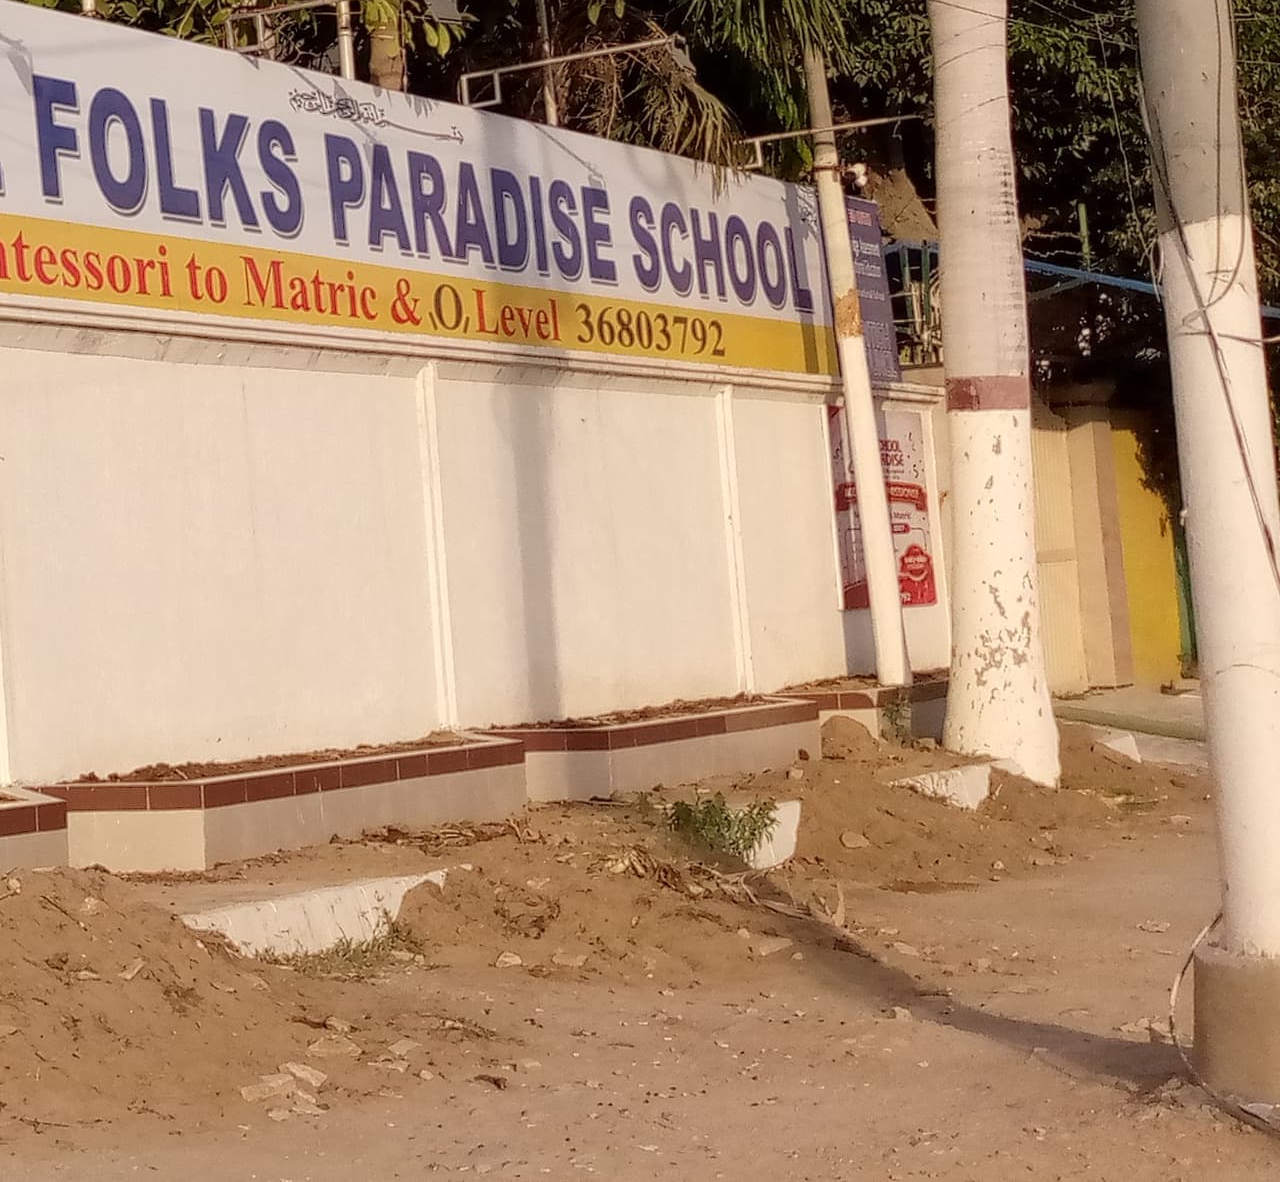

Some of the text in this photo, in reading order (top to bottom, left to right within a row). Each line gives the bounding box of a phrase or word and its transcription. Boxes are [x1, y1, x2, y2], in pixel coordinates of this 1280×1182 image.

[33, 73, 304, 239] FOLKS
[325, 132, 618, 286] PARADISE
[630, 195, 812, 312] SCHOOL
[185, 252, 228, 304] to
[240, 254, 379, 321] Matric
[390, 278, 422, 326] &
[472, 287, 561, 342] Level
[575, 302, 725, 357] 36803792
